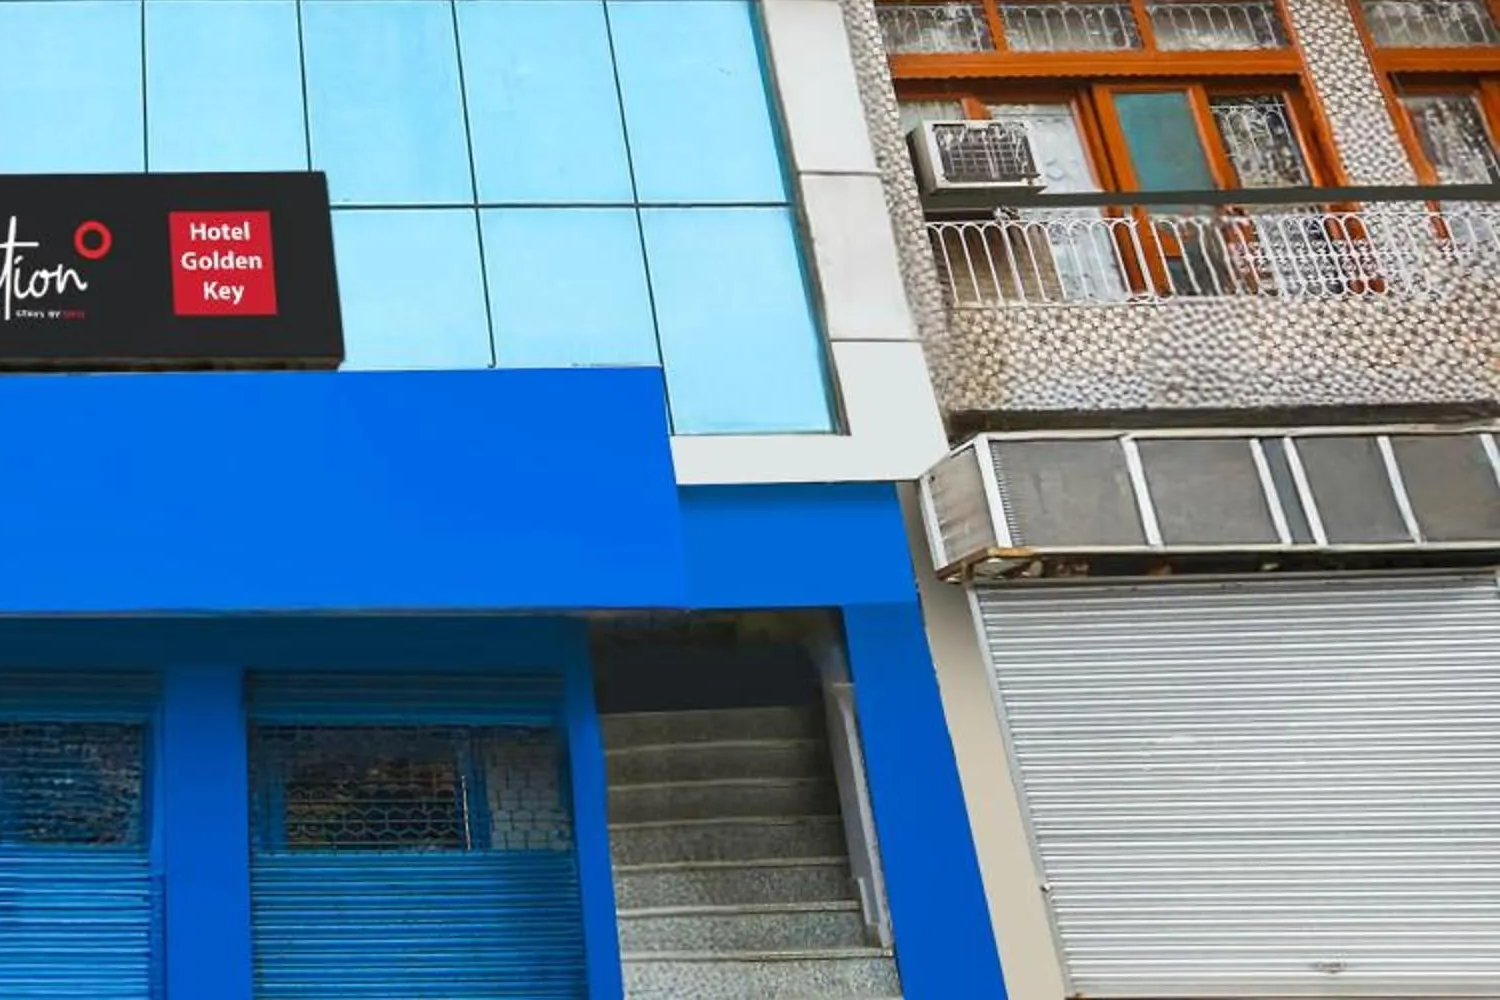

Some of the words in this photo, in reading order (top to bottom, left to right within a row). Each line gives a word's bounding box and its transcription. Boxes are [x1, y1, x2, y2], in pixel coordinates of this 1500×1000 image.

[189, 220, 252, 241] Hotel
[180, 249, 263, 271] Golden
[202, 280, 245, 305] Key
